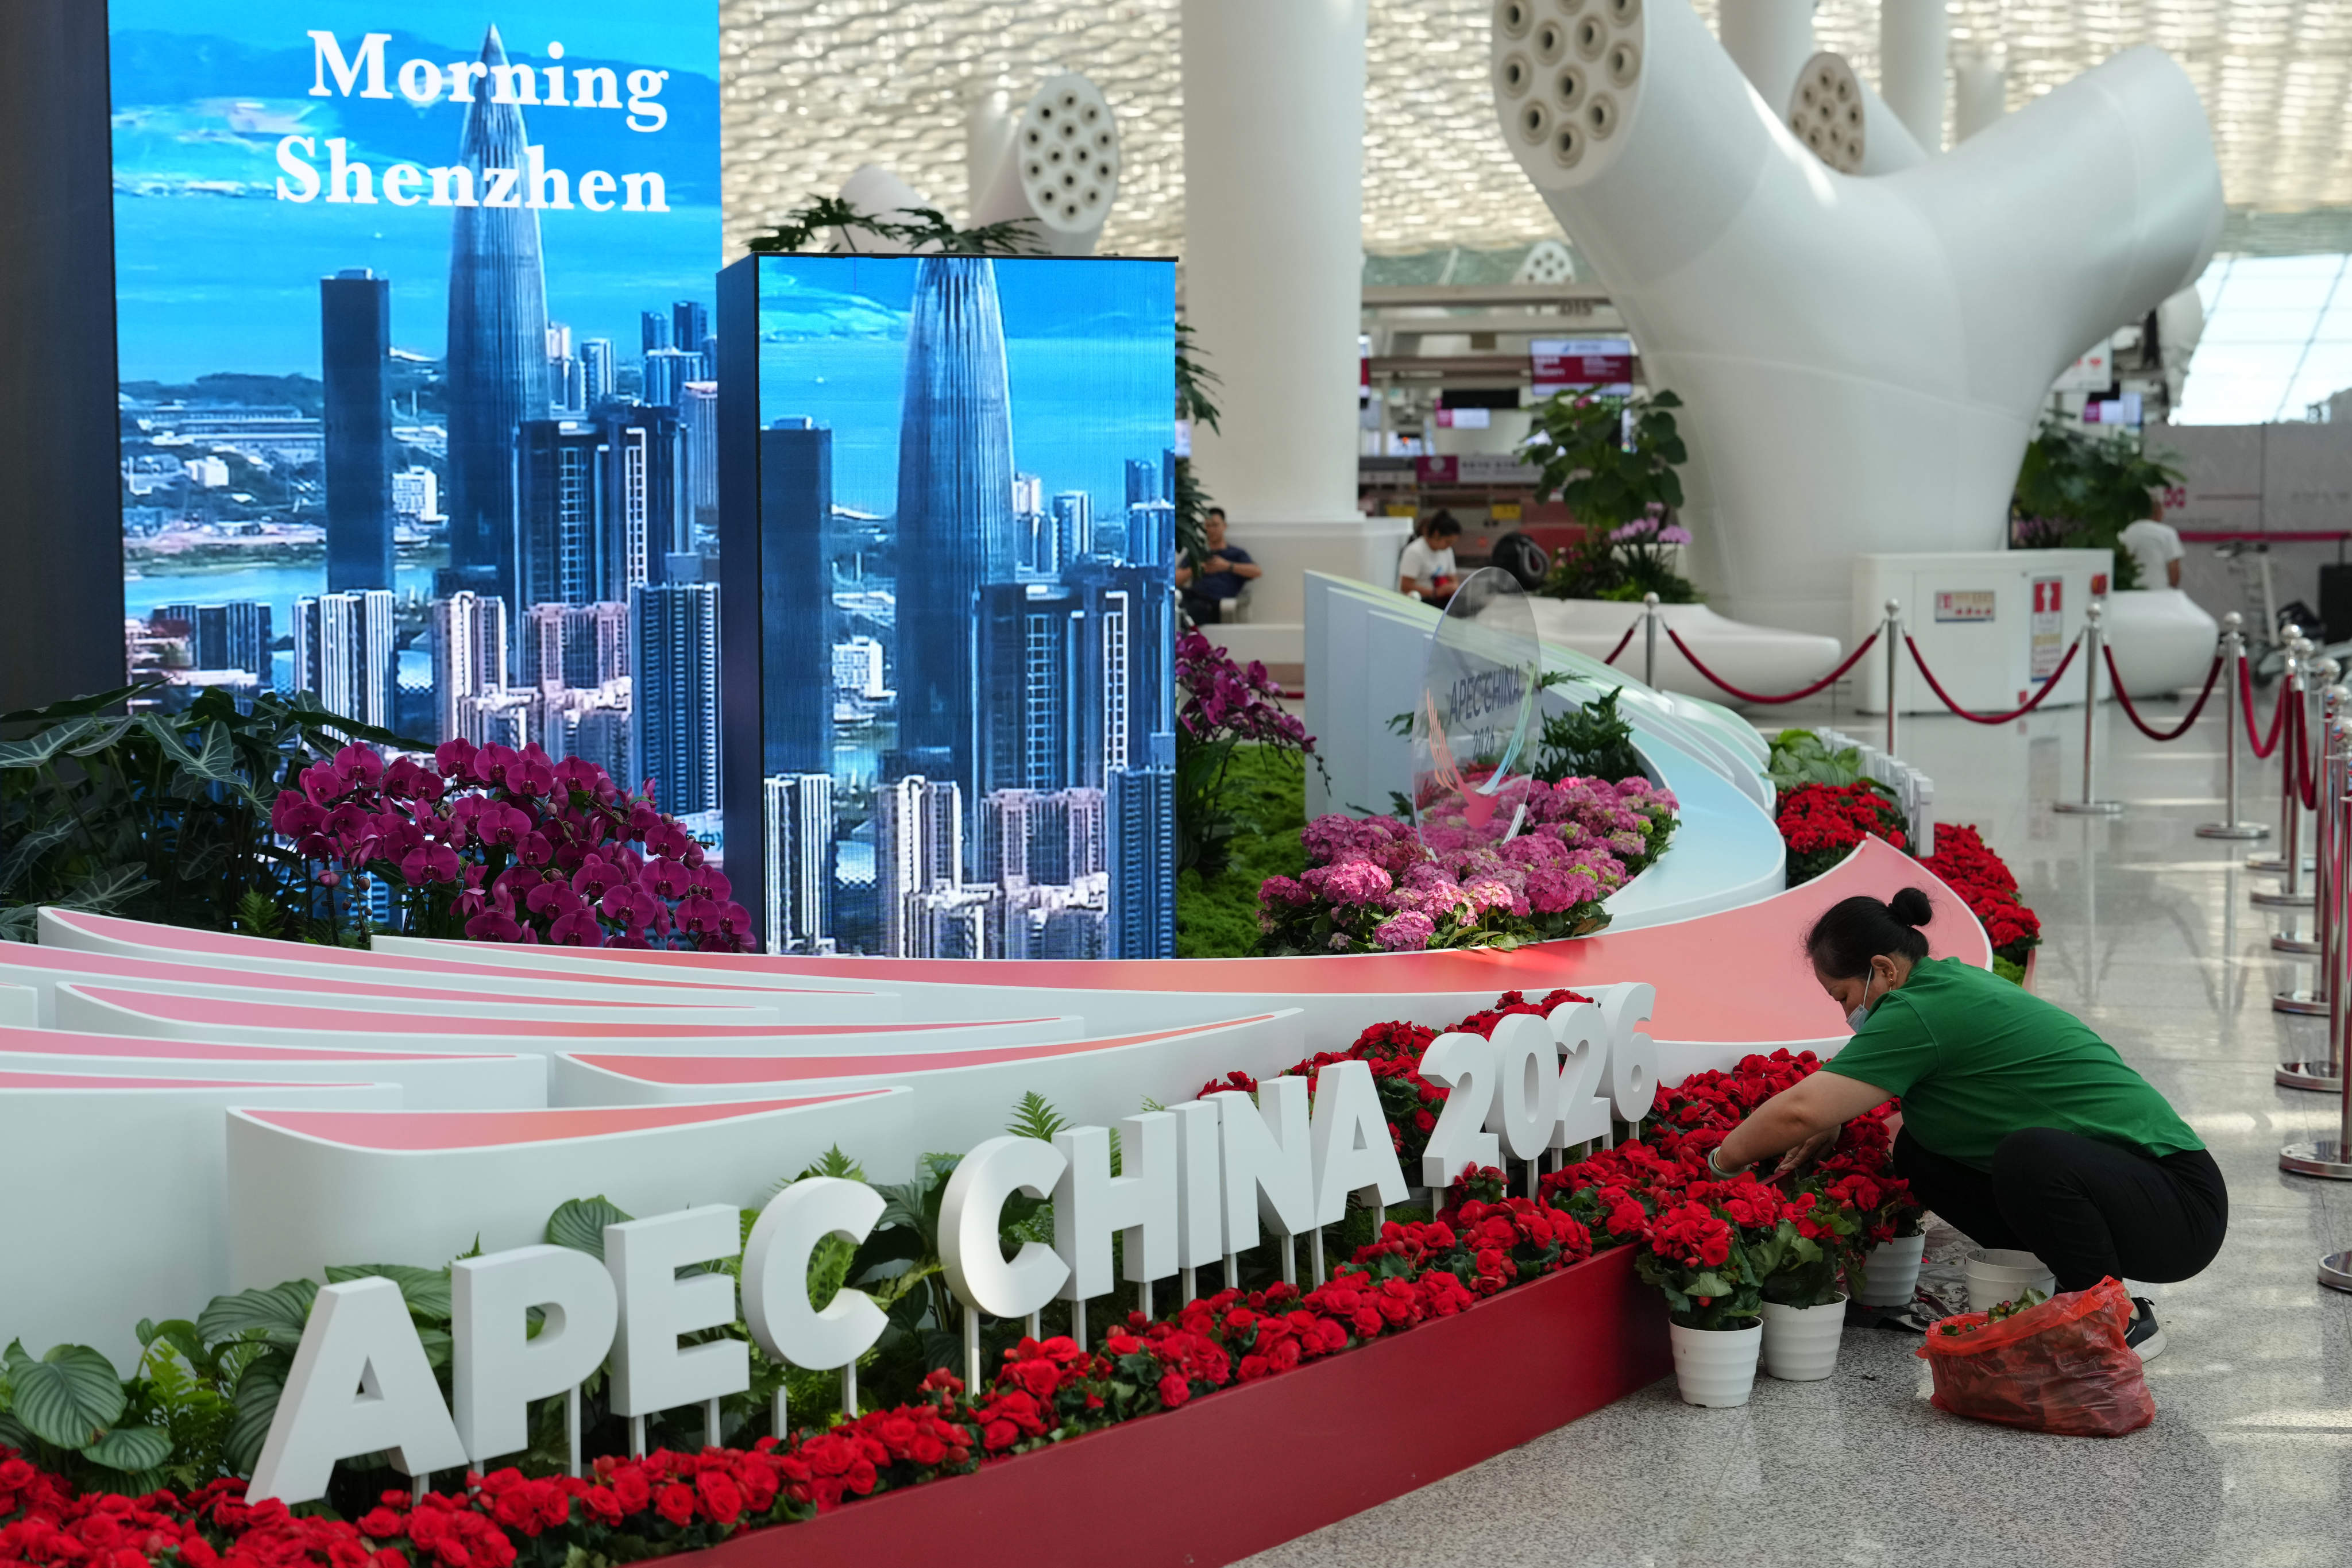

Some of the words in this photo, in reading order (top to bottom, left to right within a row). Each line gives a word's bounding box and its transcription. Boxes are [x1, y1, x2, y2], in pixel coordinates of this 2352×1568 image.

[307, 30, 669, 133] Morning
[276, 135, 670, 212] Shenzhen
[1449, 674, 1482, 725] APEC
[1484, 664, 1520, 713] CHINA
[1472, 724, 1494, 760] 2026
[246, 1176, 890, 1504] APEC
[937, 1060, 1410, 1319] CHINA
[1417, 982, 1659, 1188] 2026
